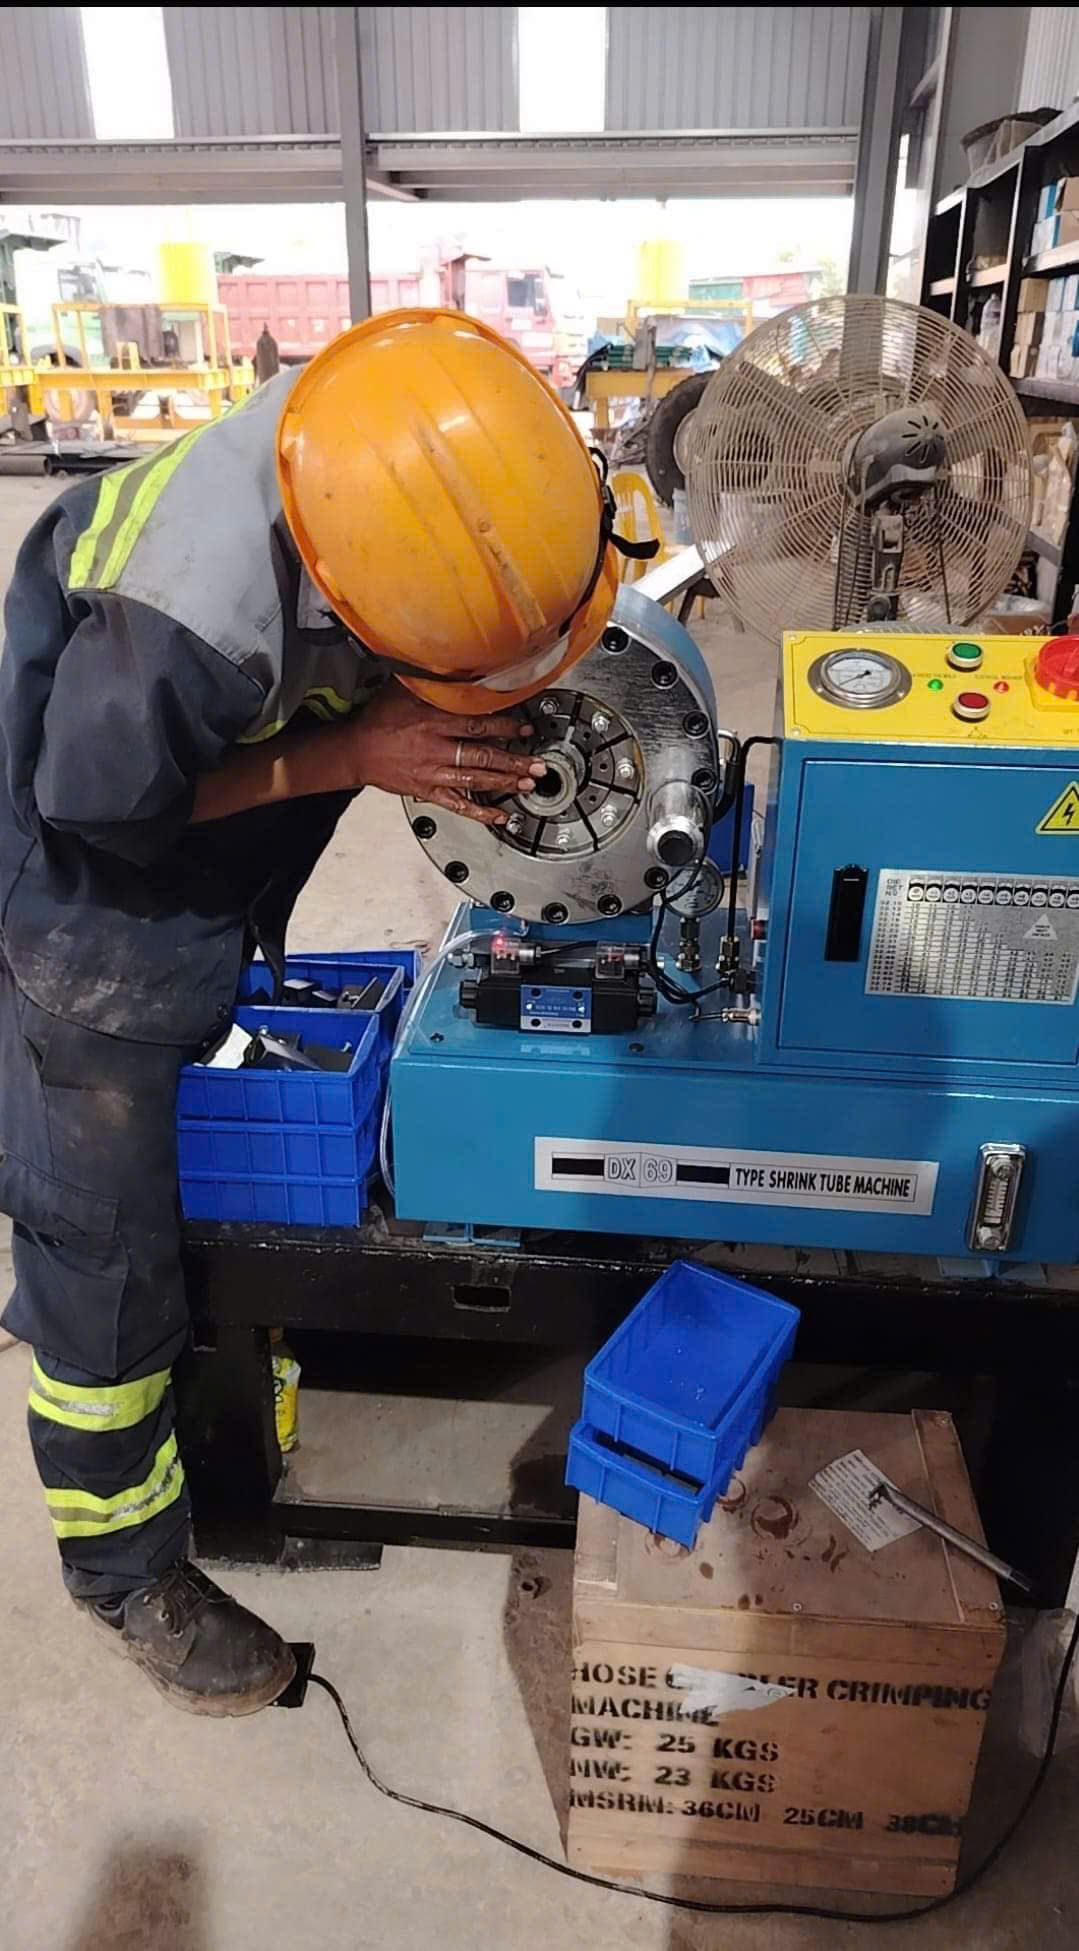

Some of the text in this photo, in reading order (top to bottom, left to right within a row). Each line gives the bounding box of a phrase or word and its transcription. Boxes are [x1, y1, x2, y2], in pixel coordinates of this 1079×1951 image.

[607, 1157, 911, 1198] DX 69 TYPE SHRINK TUBE MACHINE
[827, 1679, 993, 1710] CRIMPING
[571, 1726, 779, 1762] GW: 25 KGS
[654, 1766, 691, 1786] 23
[711, 1770, 775, 1793] KGS
[681, 1800, 760, 1823] 36CM
[783, 1807, 863, 1830] 25CM
